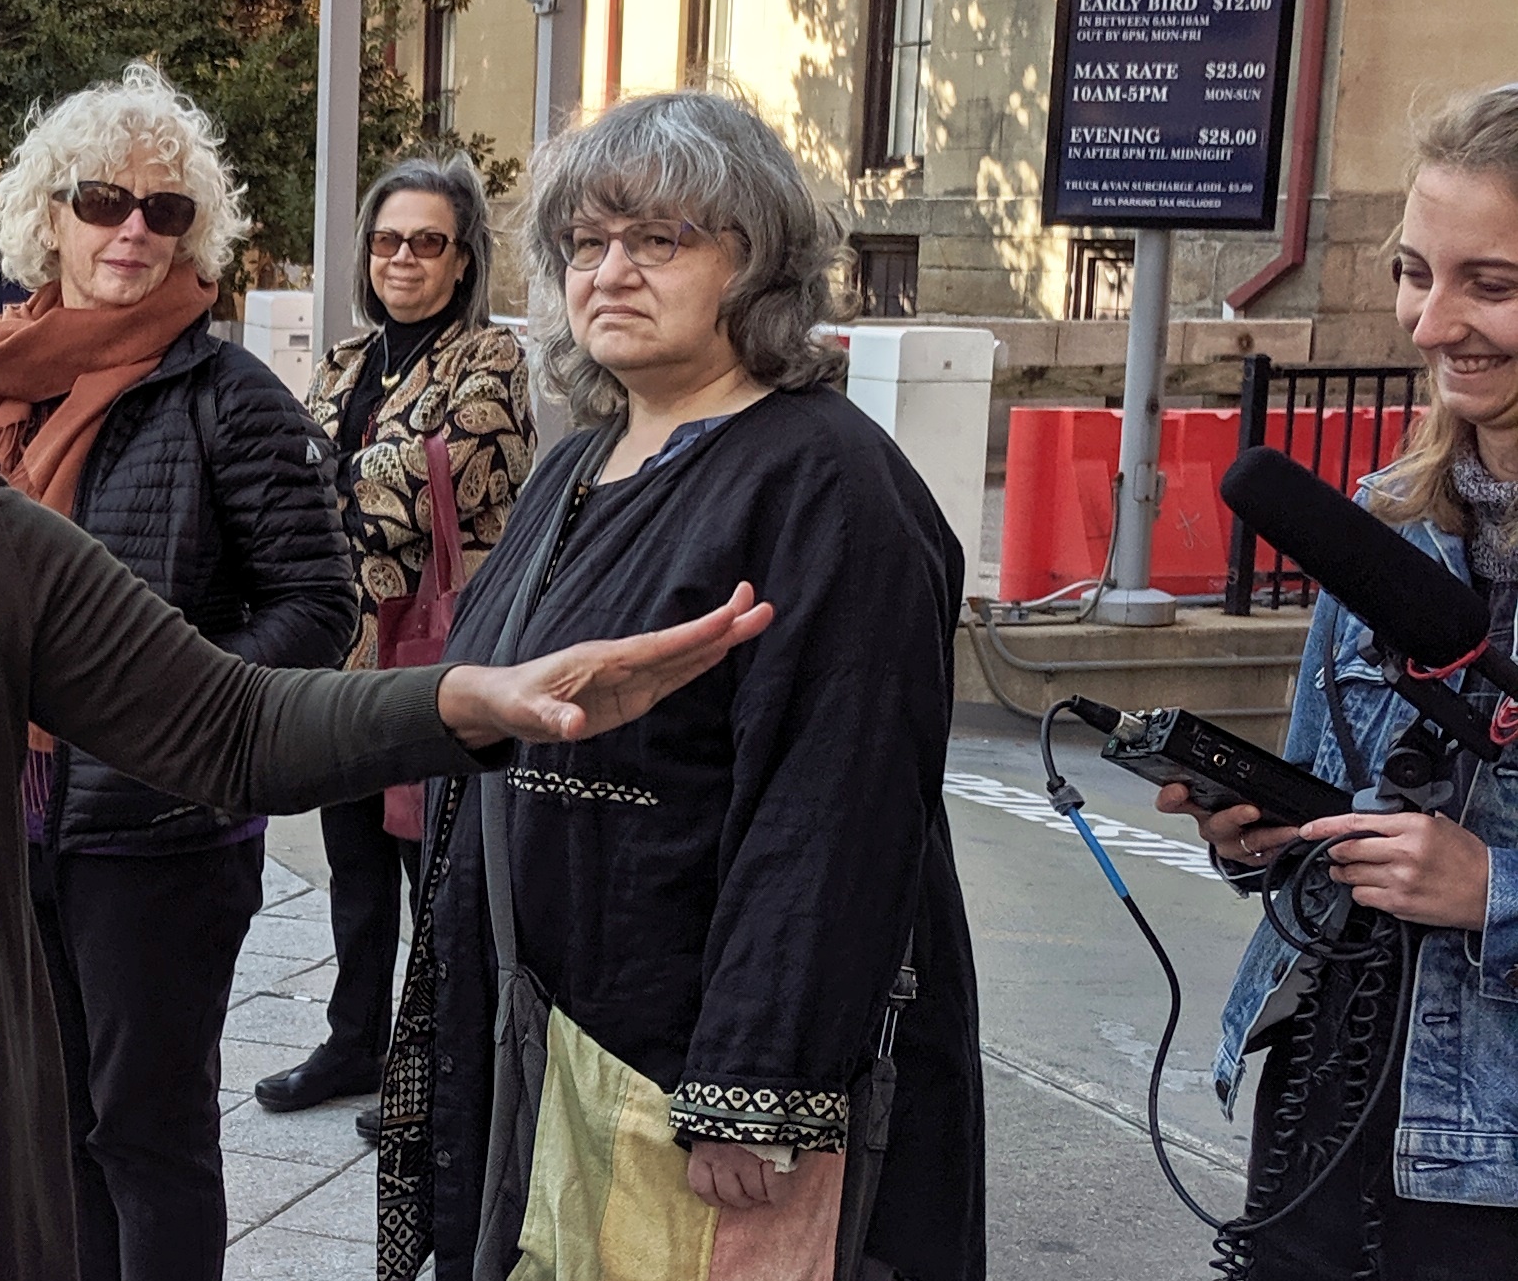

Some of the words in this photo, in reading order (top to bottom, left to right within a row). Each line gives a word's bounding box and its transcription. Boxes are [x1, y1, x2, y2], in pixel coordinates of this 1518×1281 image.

[1078, 15, 1091, 27] IN
[1094, 15, 1150, 27] BETWEEN
[1077, 30, 1104, 42] OUT
[1105, 30, 1120, 42] BY
[1151, 29, 1202, 41] MON-FRI
[1073, 62, 1120, 80] MAX
[1125, 61, 1179, 80] RATE
[1072, 85, 1168, 102] 10AM-5PM
[1204, 88, 1261, 101] MON-SUN
[1070, 126, 1161, 144] EVENING
[1198, 127, 1257, 146] $28.00
[1068, 147, 1081, 159] IN
[1084, 147, 1120, 160] AFTER
[1148, 148, 1168, 160] TIL
[1170, 147, 1233, 161] MIDNIGHT
[1065, 180, 1100, 191] TRUCK
[1109, 180, 1131, 191] VAN
[1132, 181, 1193, 192] SURCHARGE
